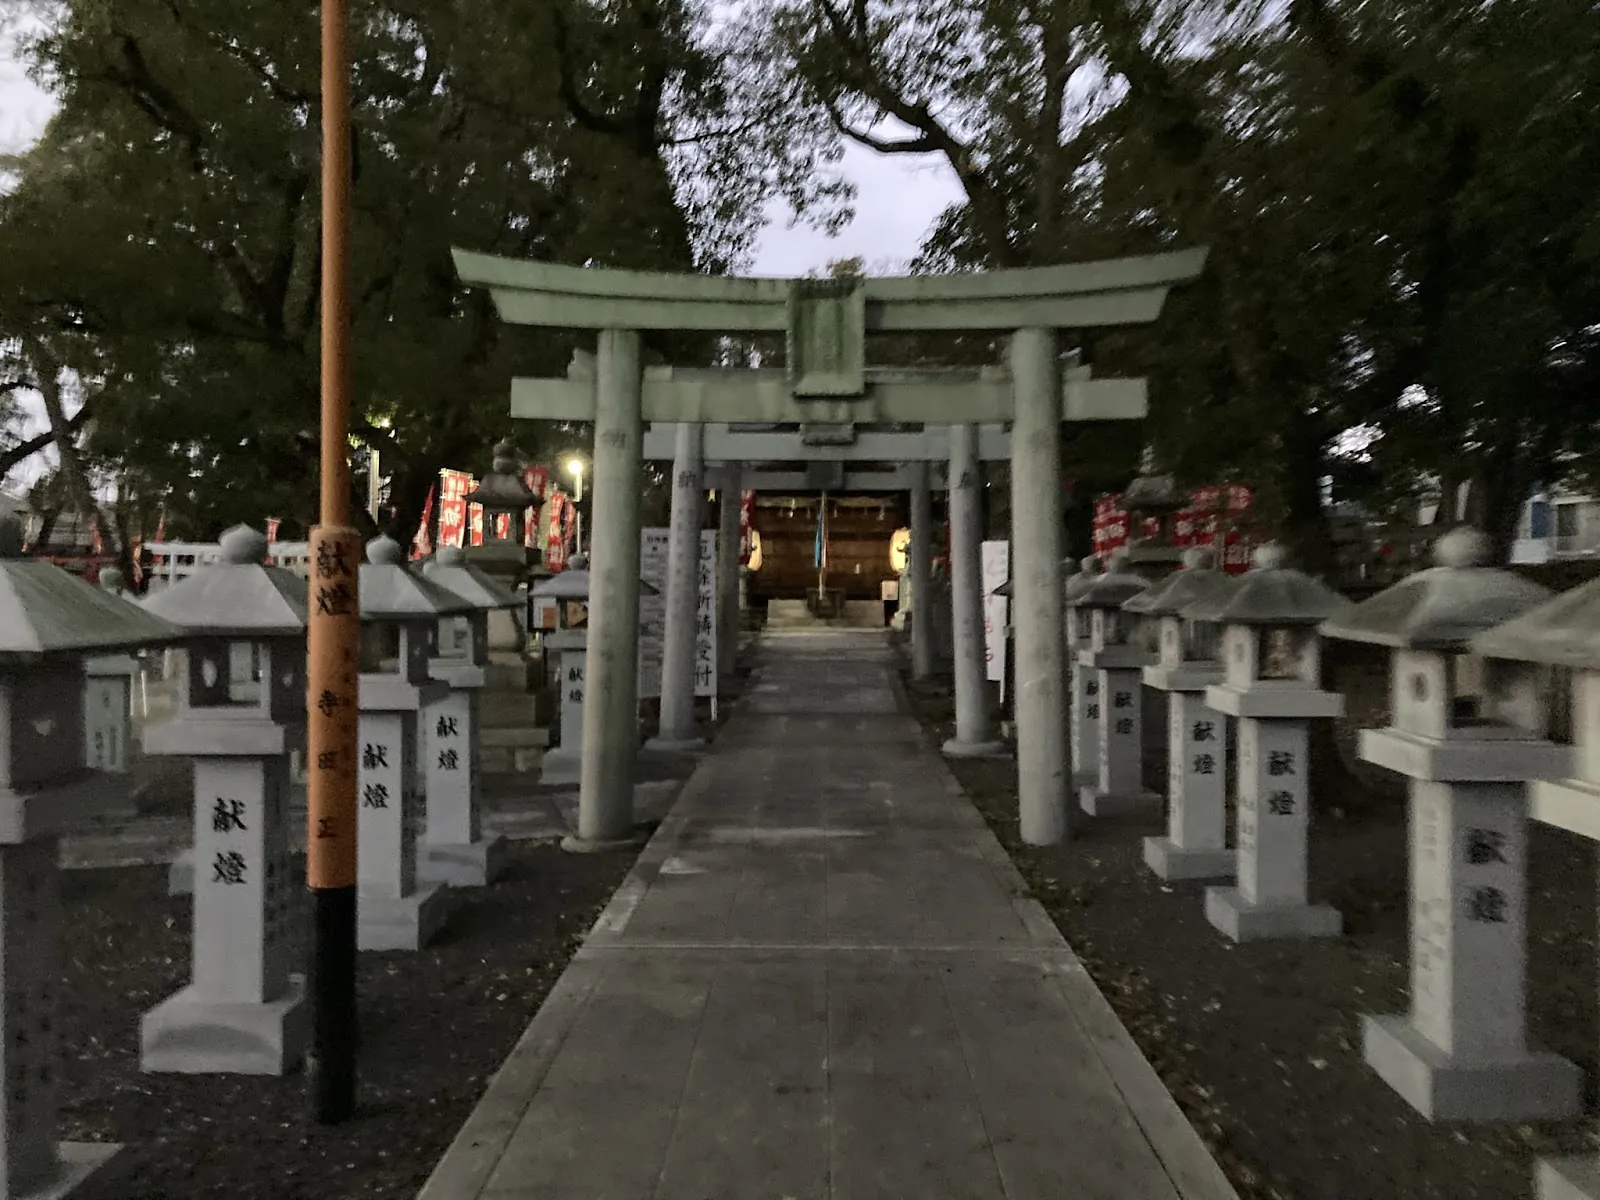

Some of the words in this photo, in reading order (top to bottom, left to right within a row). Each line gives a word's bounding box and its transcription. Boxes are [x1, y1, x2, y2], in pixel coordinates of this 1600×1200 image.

[568, 667, 583, 704] 献燈
[436, 714, 459, 771] 献燈
[1191, 719, 1217, 776] 献燈
[362, 743, 391, 810] 献燈
[1266, 749, 1297, 817] 献燈
[211, 797, 248, 886] 献燈
